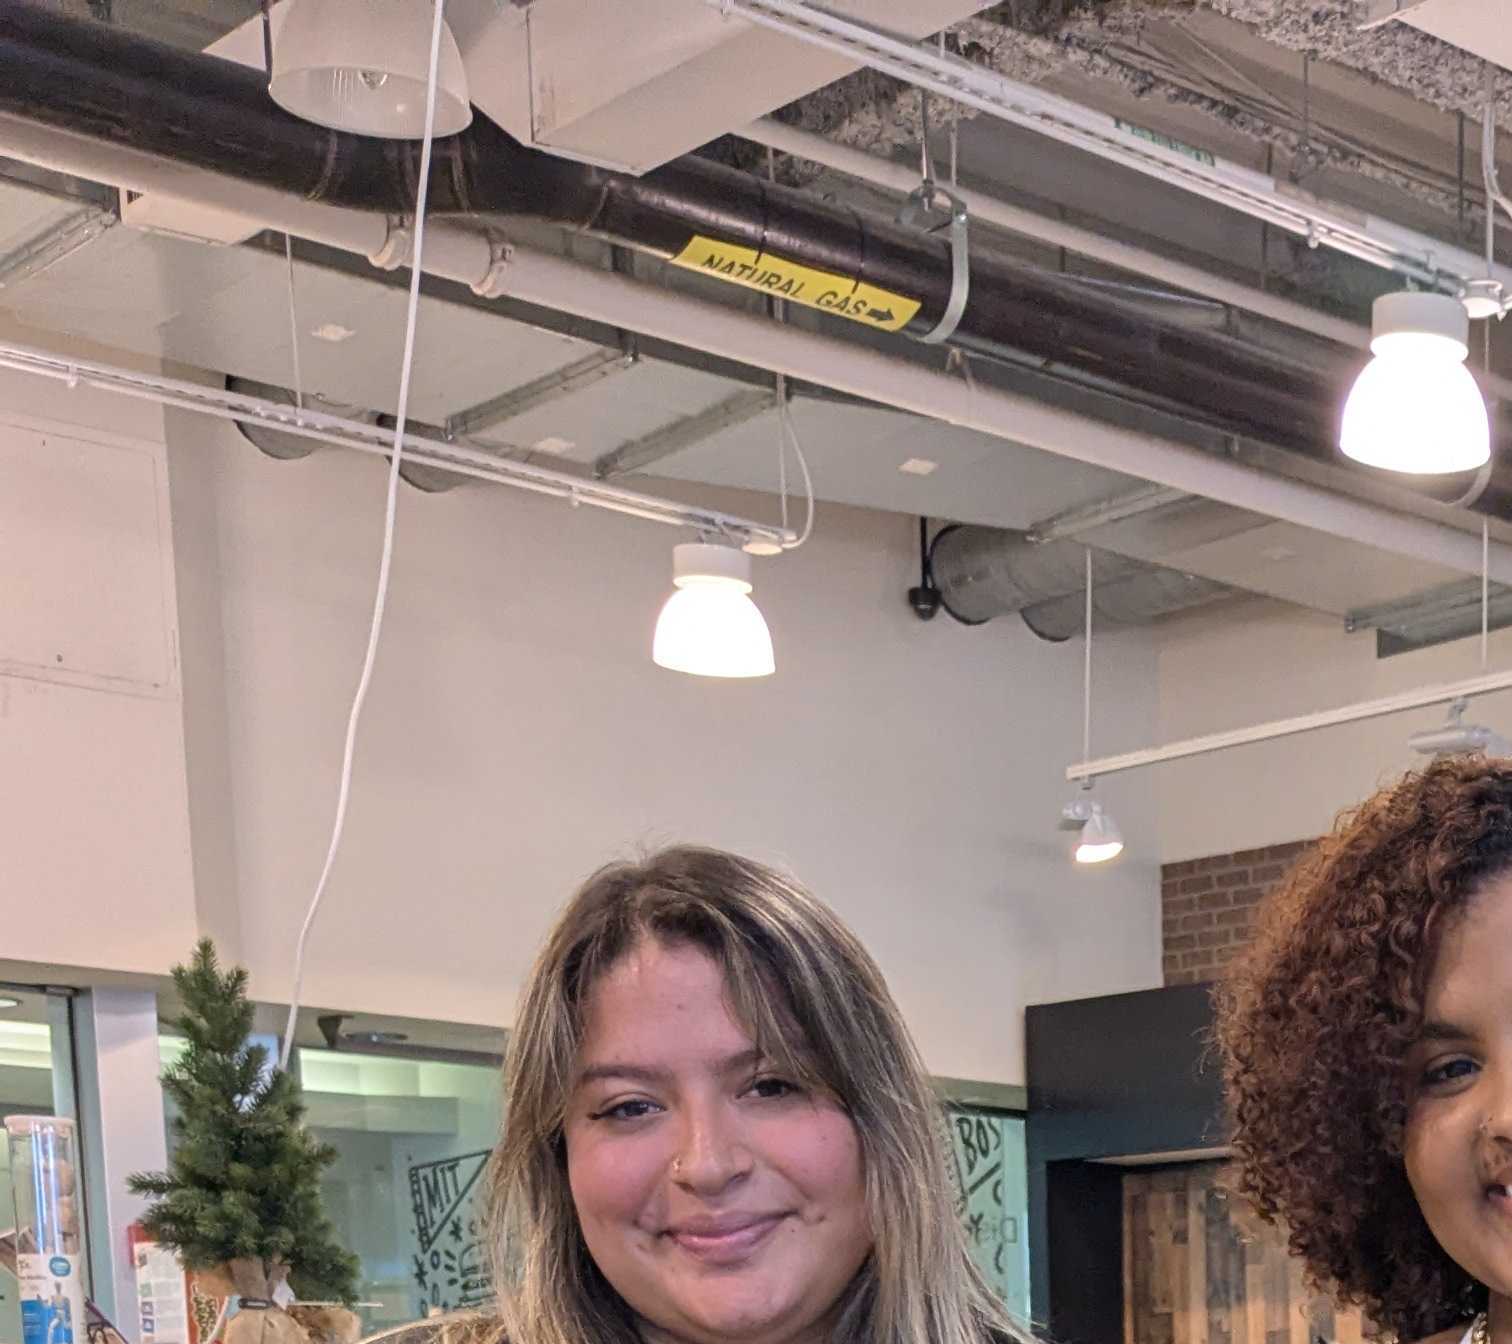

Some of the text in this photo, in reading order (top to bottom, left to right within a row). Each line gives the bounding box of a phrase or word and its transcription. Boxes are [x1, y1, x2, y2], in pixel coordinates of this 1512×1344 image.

[701, 253, 868, 317] NATURAL GAS
[422, 1161, 460, 1228] MIT
